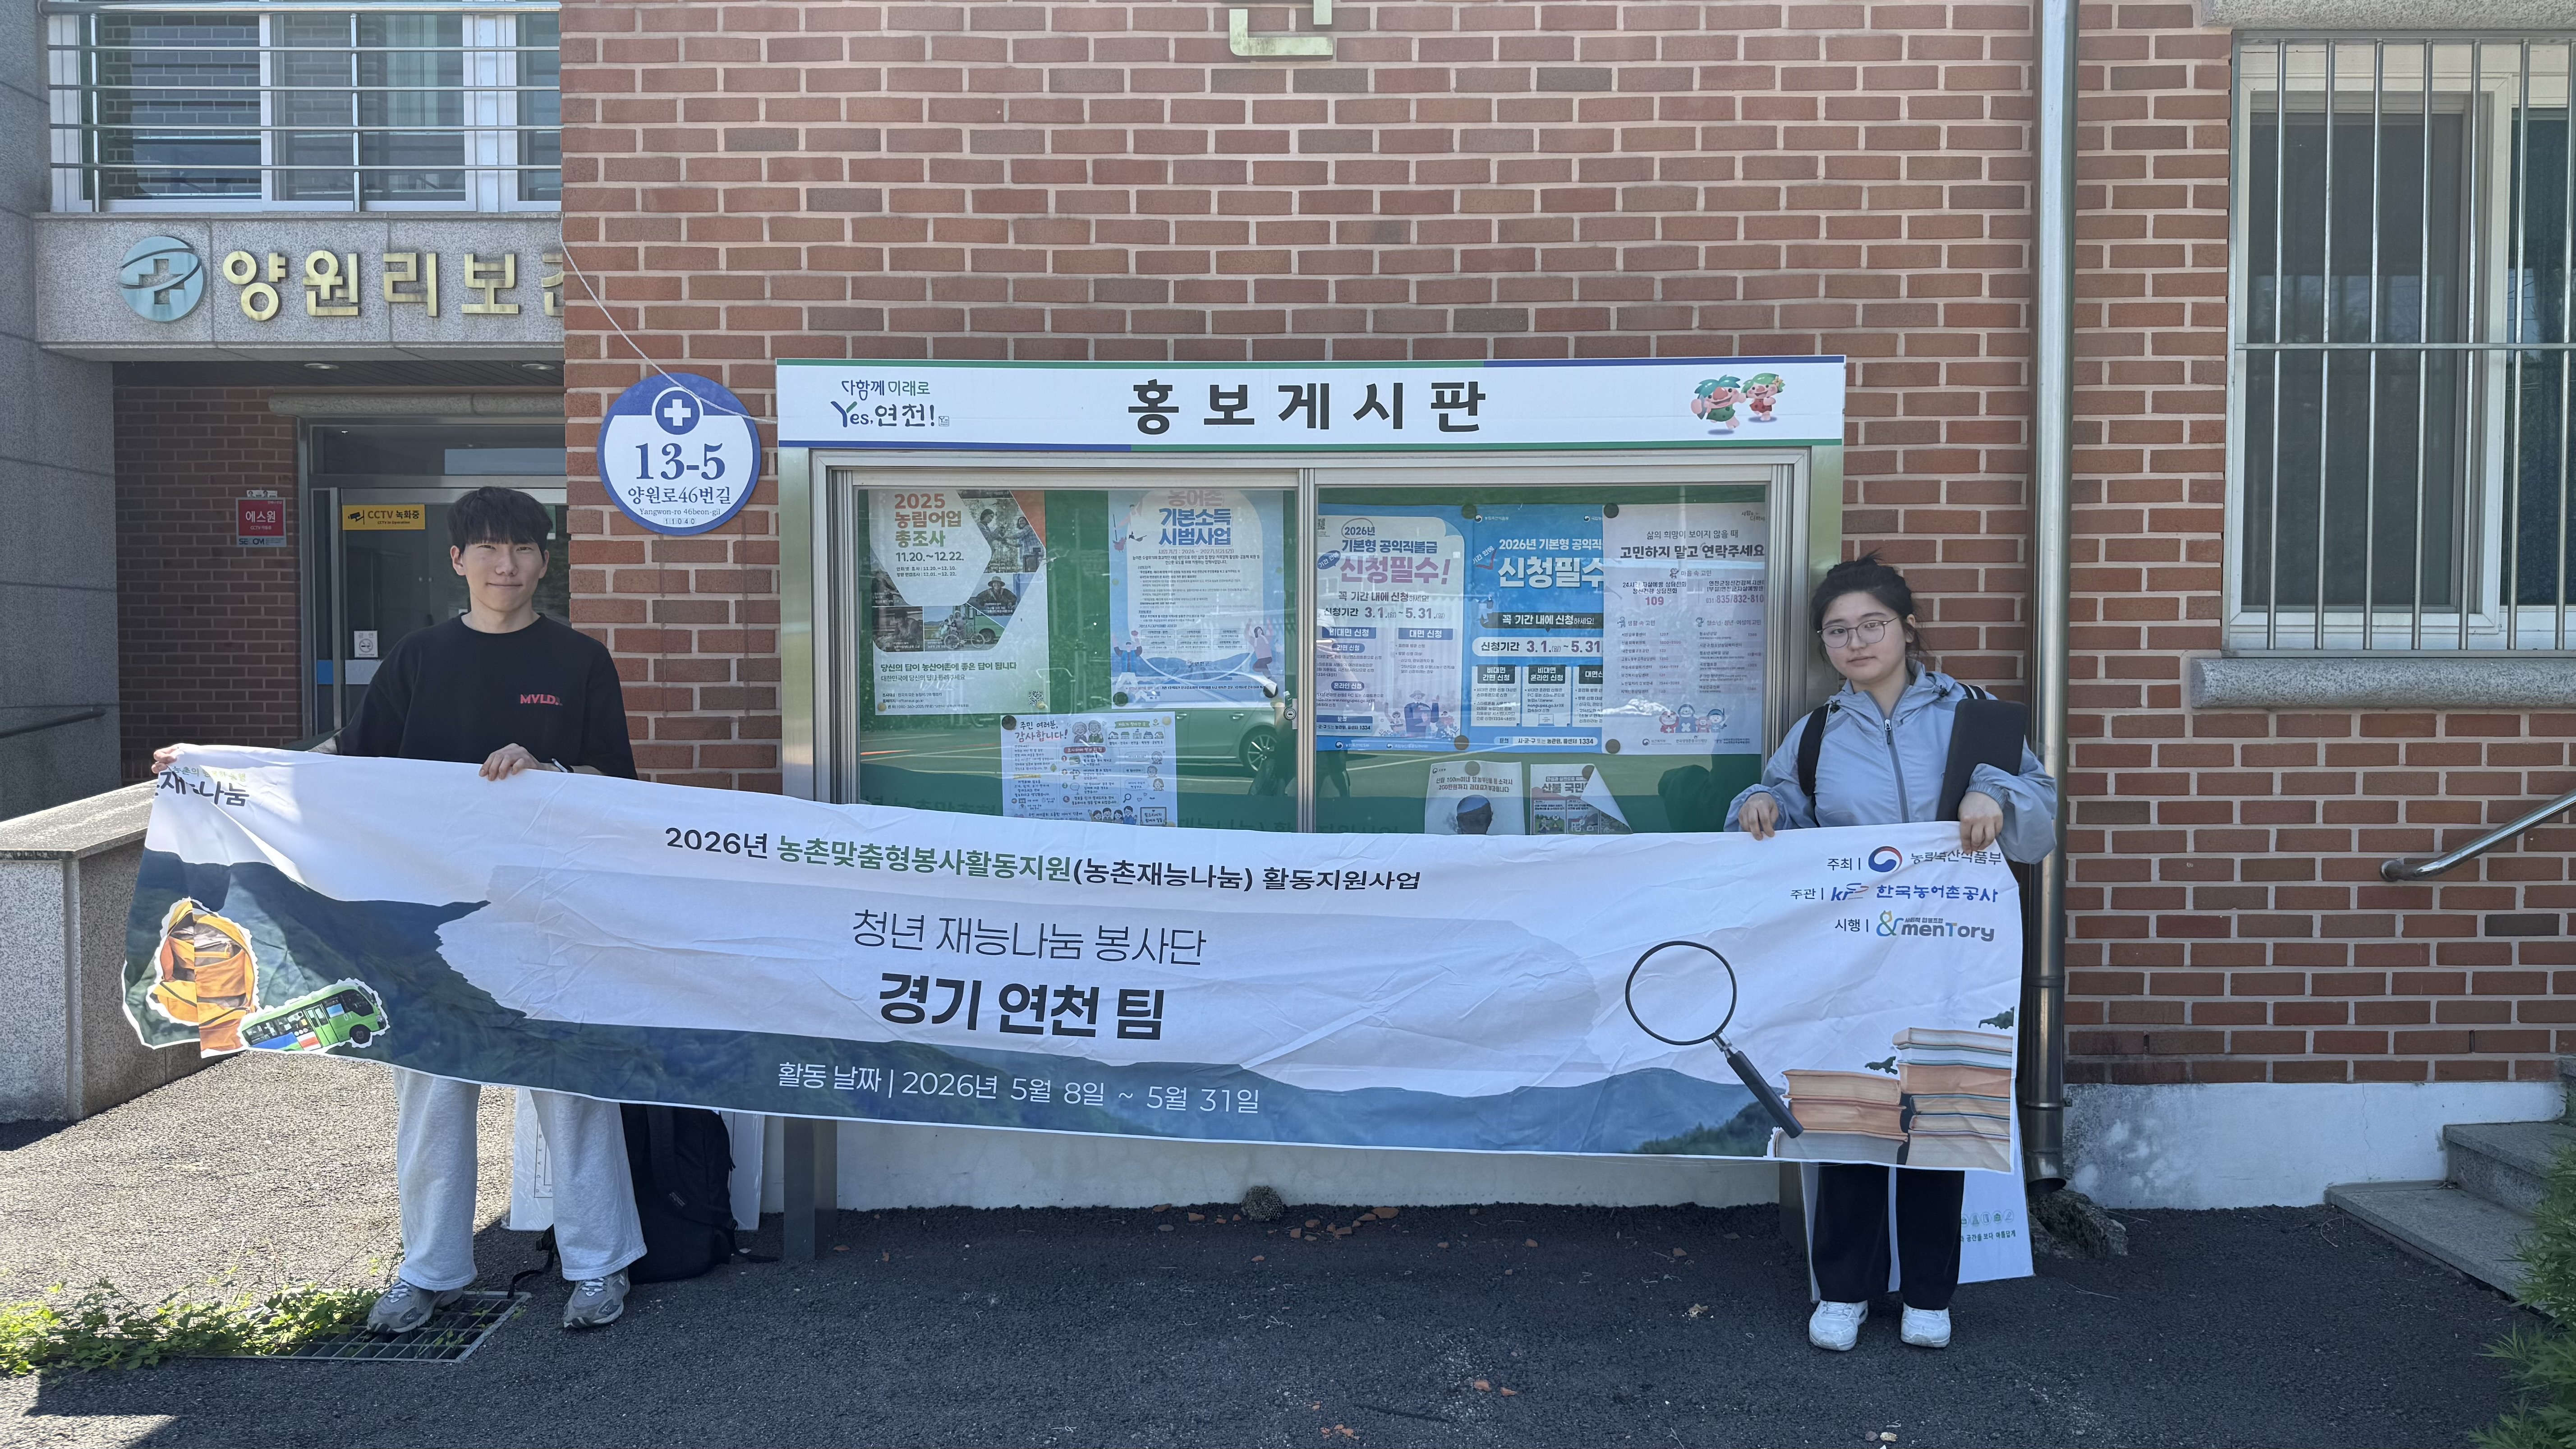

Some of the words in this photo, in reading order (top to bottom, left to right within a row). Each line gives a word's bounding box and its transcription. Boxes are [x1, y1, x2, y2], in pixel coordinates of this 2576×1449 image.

[842, 380, 884, 400] 다함께
[888, 380, 930, 396] 미래로
[635, 442, 725, 480] 13-5
[628, 486, 731, 504] 양원로46번길
[894, 493, 945, 509] 2025
[246, 511, 276, 523] 에스원
[368, 511, 393, 519] CCTV
[396, 510, 419, 519] 녹화중
[639, 508, 681, 516] Yangwon-ro
[1159, 508, 1232, 527] 기본소득
[895, 511, 961, 529] 농림어업
[1159, 528, 1231, 546] 시범사업
[1344, 526, 1375, 536] 2026년
[1647, 530, 1661, 539] 삶의
[1664, 530, 1686, 539] 희망이
[1688, 530, 1711, 538] 보이지
[1730, 529, 1739, 538] 때
[895, 530, 946, 548] 총조사
[1499, 539, 1536, 550] 2026년
[1539, 539, 1569, 551] 기본형
[1572, 539, 1602, 551] 공익직
[1342, 540, 1376, 553] 기본형
[1380, 541, 1438, 554] 공익직불금
[1620, 546, 1670, 559] 고민하지
[1674, 545, 1698, 558] 말고
[1702, 544, 1765, 558] 연락주세요
[1340, 556, 1451, 585] 신청필수!
[1339, 592, 1348, 601] 꼭
[1351, 591, 1369, 602] 기간
[1371, 592, 1389, 602] 내에
[1391, 592, 1429, 603] 신청하세요!
[1645, 596, 1664, 606] 109
[1324, 607, 1358, 617] 신청기간
[1502, 615, 1511, 624] 꼭
[1515, 614, 1534, 624] 기간
[1536, 615, 1554, 625] 내에
[1555, 614, 1594, 625] 신청하세요!
[1329, 629, 1352, 637] 비대면
[1409, 630, 1424, 638] 대면
[1427, 630, 1442, 638] 신청
[1481, 642, 1520, 651] 신청기간
[995, 662, 1017, 670] 됩니다
[1020, 722, 1034, 730] 주민
[1036, 720, 1058, 730] 여러분,
[1015, 730, 1068, 743] 감사합니다!
[1542, 783, 1561, 793] 산불
[1565, 783, 1587, 793] 국민
[665, 827, 768, 860] 2026년
[1262, 866, 1421, 891] 활동지원사업
[1826, 857, 1853, 872] 주최
[1789, 889, 1817, 900] 주관
[1876, 885, 1998, 903] 한국농어촌공사
[1835, 919, 1861, 933] 시행
[852, 908, 926, 951] 청년
[936, 916, 1084, 960] 재능나눔
[1094, 924, 1207, 966] 봉사단
[879, 972, 982, 1031] 경기
[998, 983, 1100, 1038] 연천
[1116, 988, 1165, 1040] 팀
[777, 1062, 827, 1090] 활동
[833, 1065, 883, 1093] 날짜
[902, 1070, 997, 1100] 2026년
[1011, 1077, 1052, 1104] 5월
[1063, 1081, 1105, 1107] 8일
[1146, 1085, 1187, 1111] 5월
[1199, 1088, 1259, 1114] 31일
